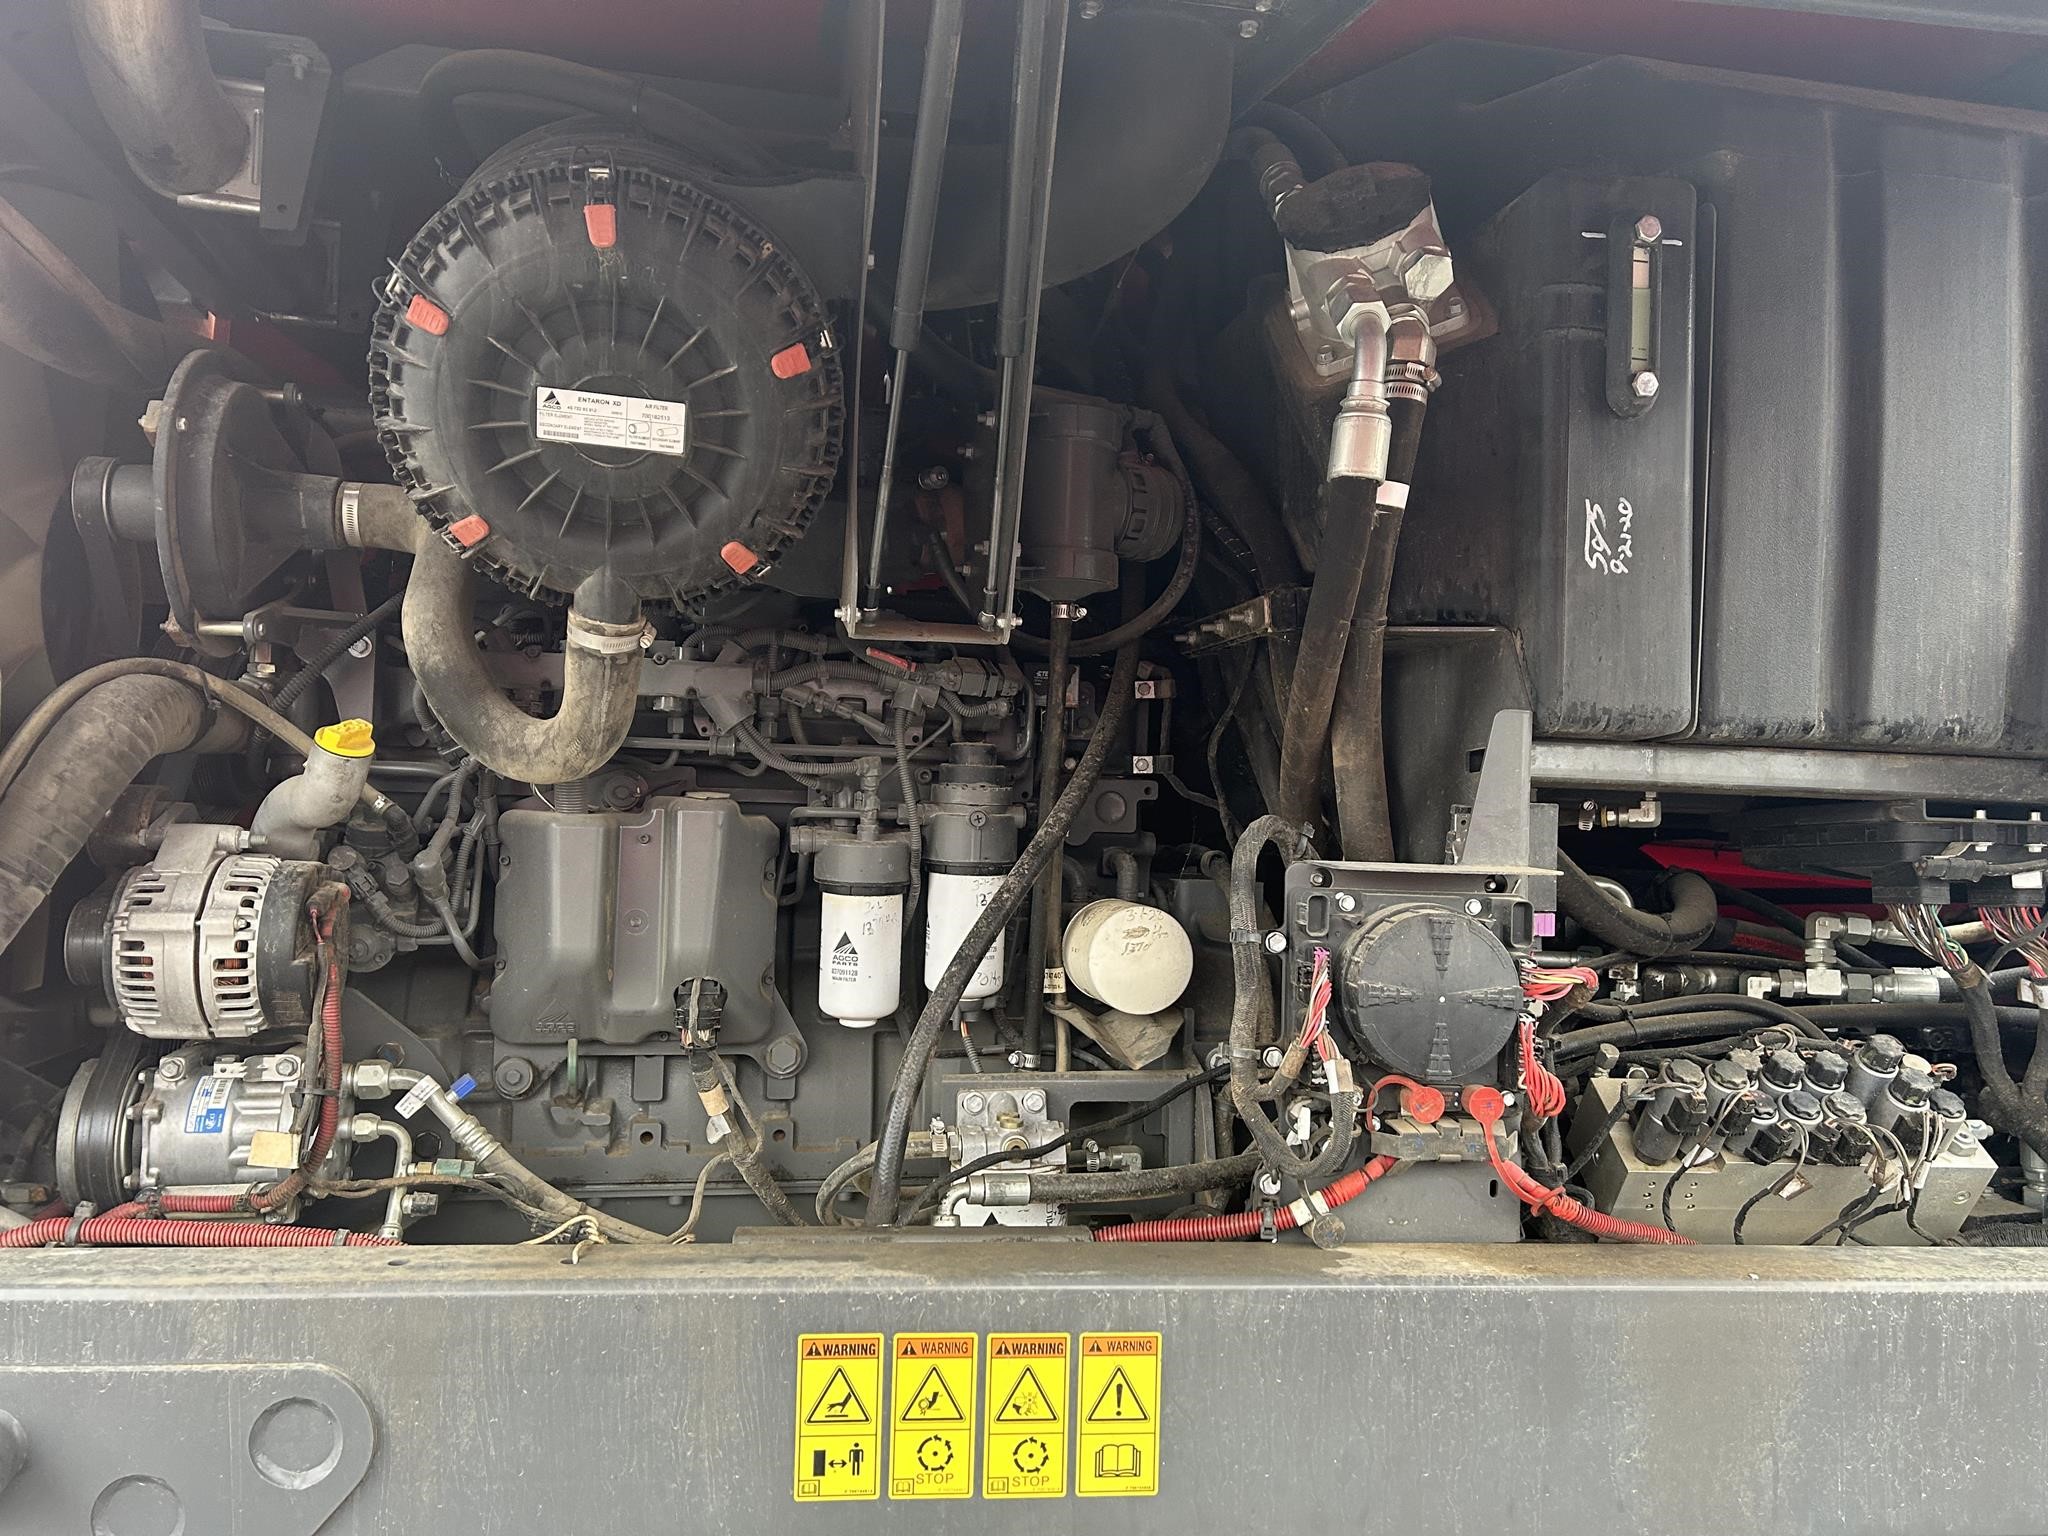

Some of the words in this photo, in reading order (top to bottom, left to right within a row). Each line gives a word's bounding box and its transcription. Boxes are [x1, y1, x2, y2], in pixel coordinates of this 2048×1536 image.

[577, 396, 610, 405] ENTARON
[612, 399, 622, 407] XD
[832, 954, 859, 962] AGCO
[822, 1343, 876, 1356] WARNING
[921, 1341, 969, 1354] WARNING
[1012, 1342, 1064, 1355] WARNING
[1107, 1340, 1153, 1352] WARNING
[916, 1472, 954, 1485] STOP
[1012, 1475, 1050, 1487] STOP
